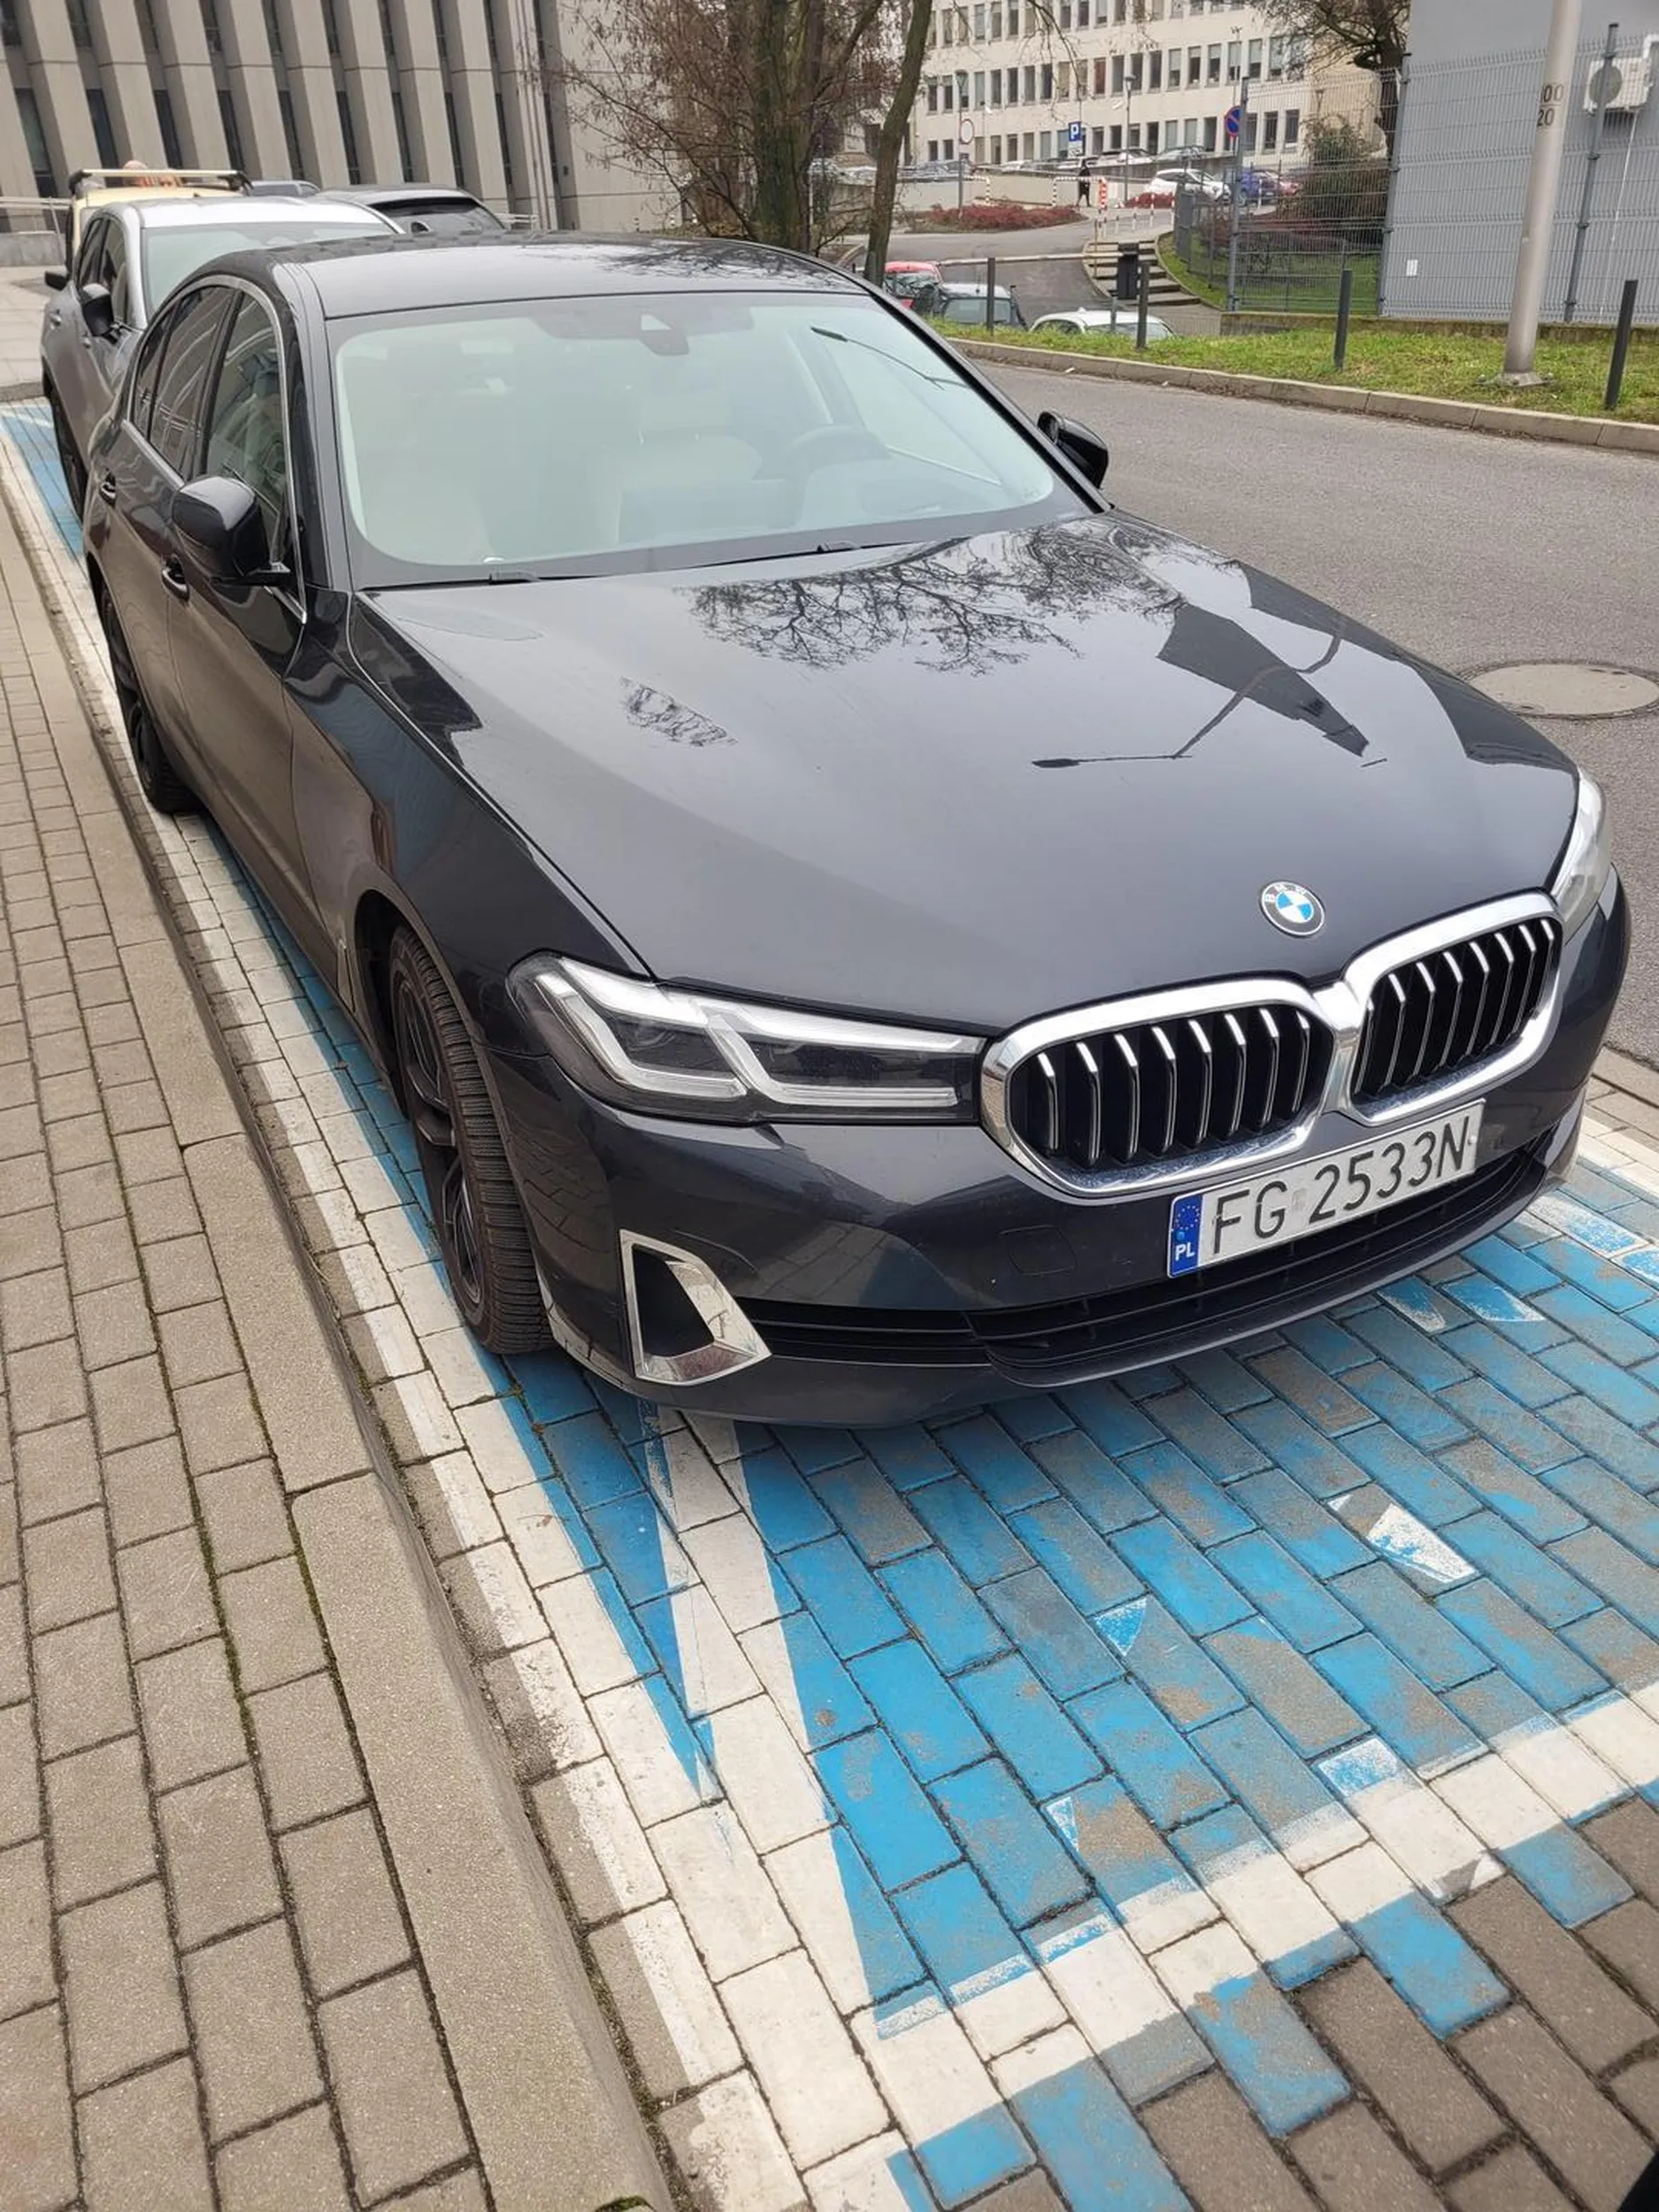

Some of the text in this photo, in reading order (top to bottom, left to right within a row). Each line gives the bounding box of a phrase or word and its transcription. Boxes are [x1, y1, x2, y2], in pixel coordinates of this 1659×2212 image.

[1537, 108, 1555, 127] 20
[1071, 124, 1079, 140] P
[1213, 1116, 1470, 1254] FG 2533N
[1175, 1242, 1195, 1261] PL
